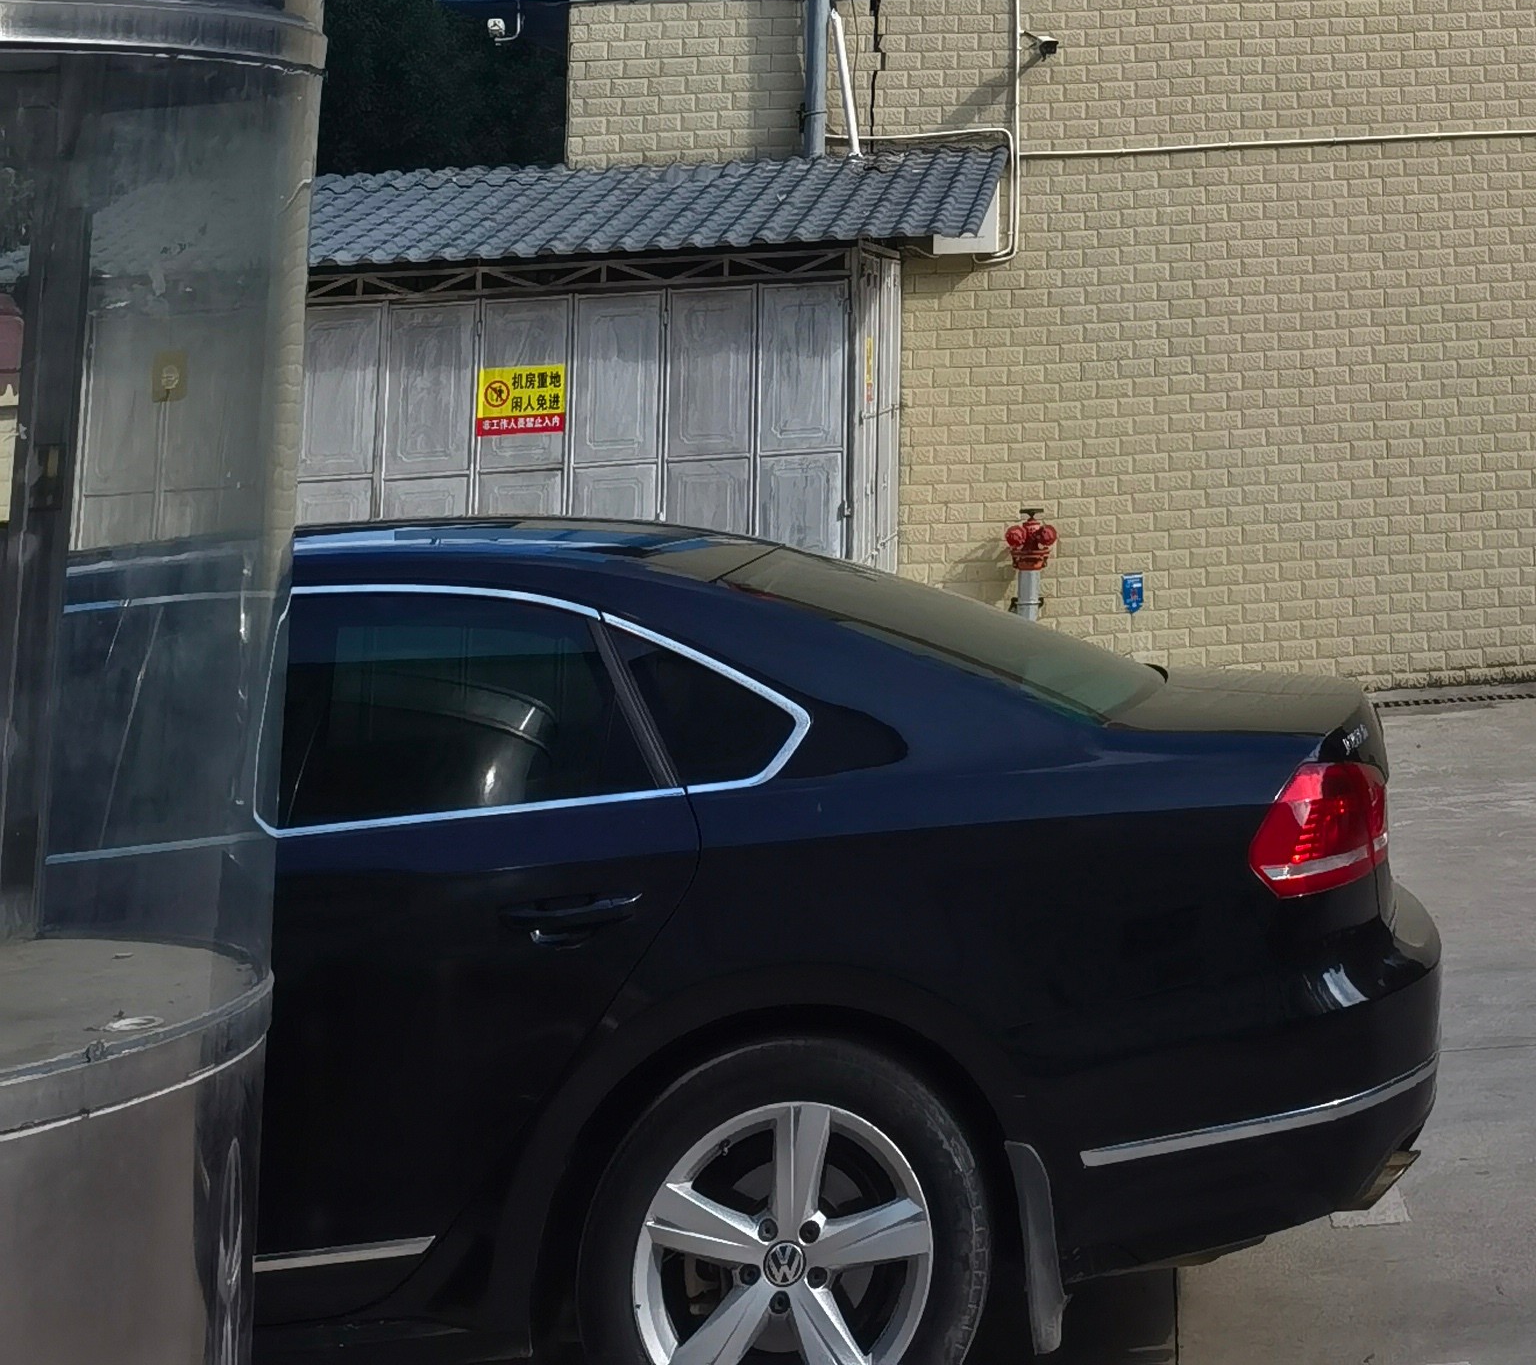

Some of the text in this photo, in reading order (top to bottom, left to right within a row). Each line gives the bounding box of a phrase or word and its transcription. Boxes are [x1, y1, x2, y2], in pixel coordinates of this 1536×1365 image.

[511, 371, 562, 390] 机房重地
[511, 392, 560, 412] 闲人免进
[482, 415, 561, 430] 非工作人员禁止入内
